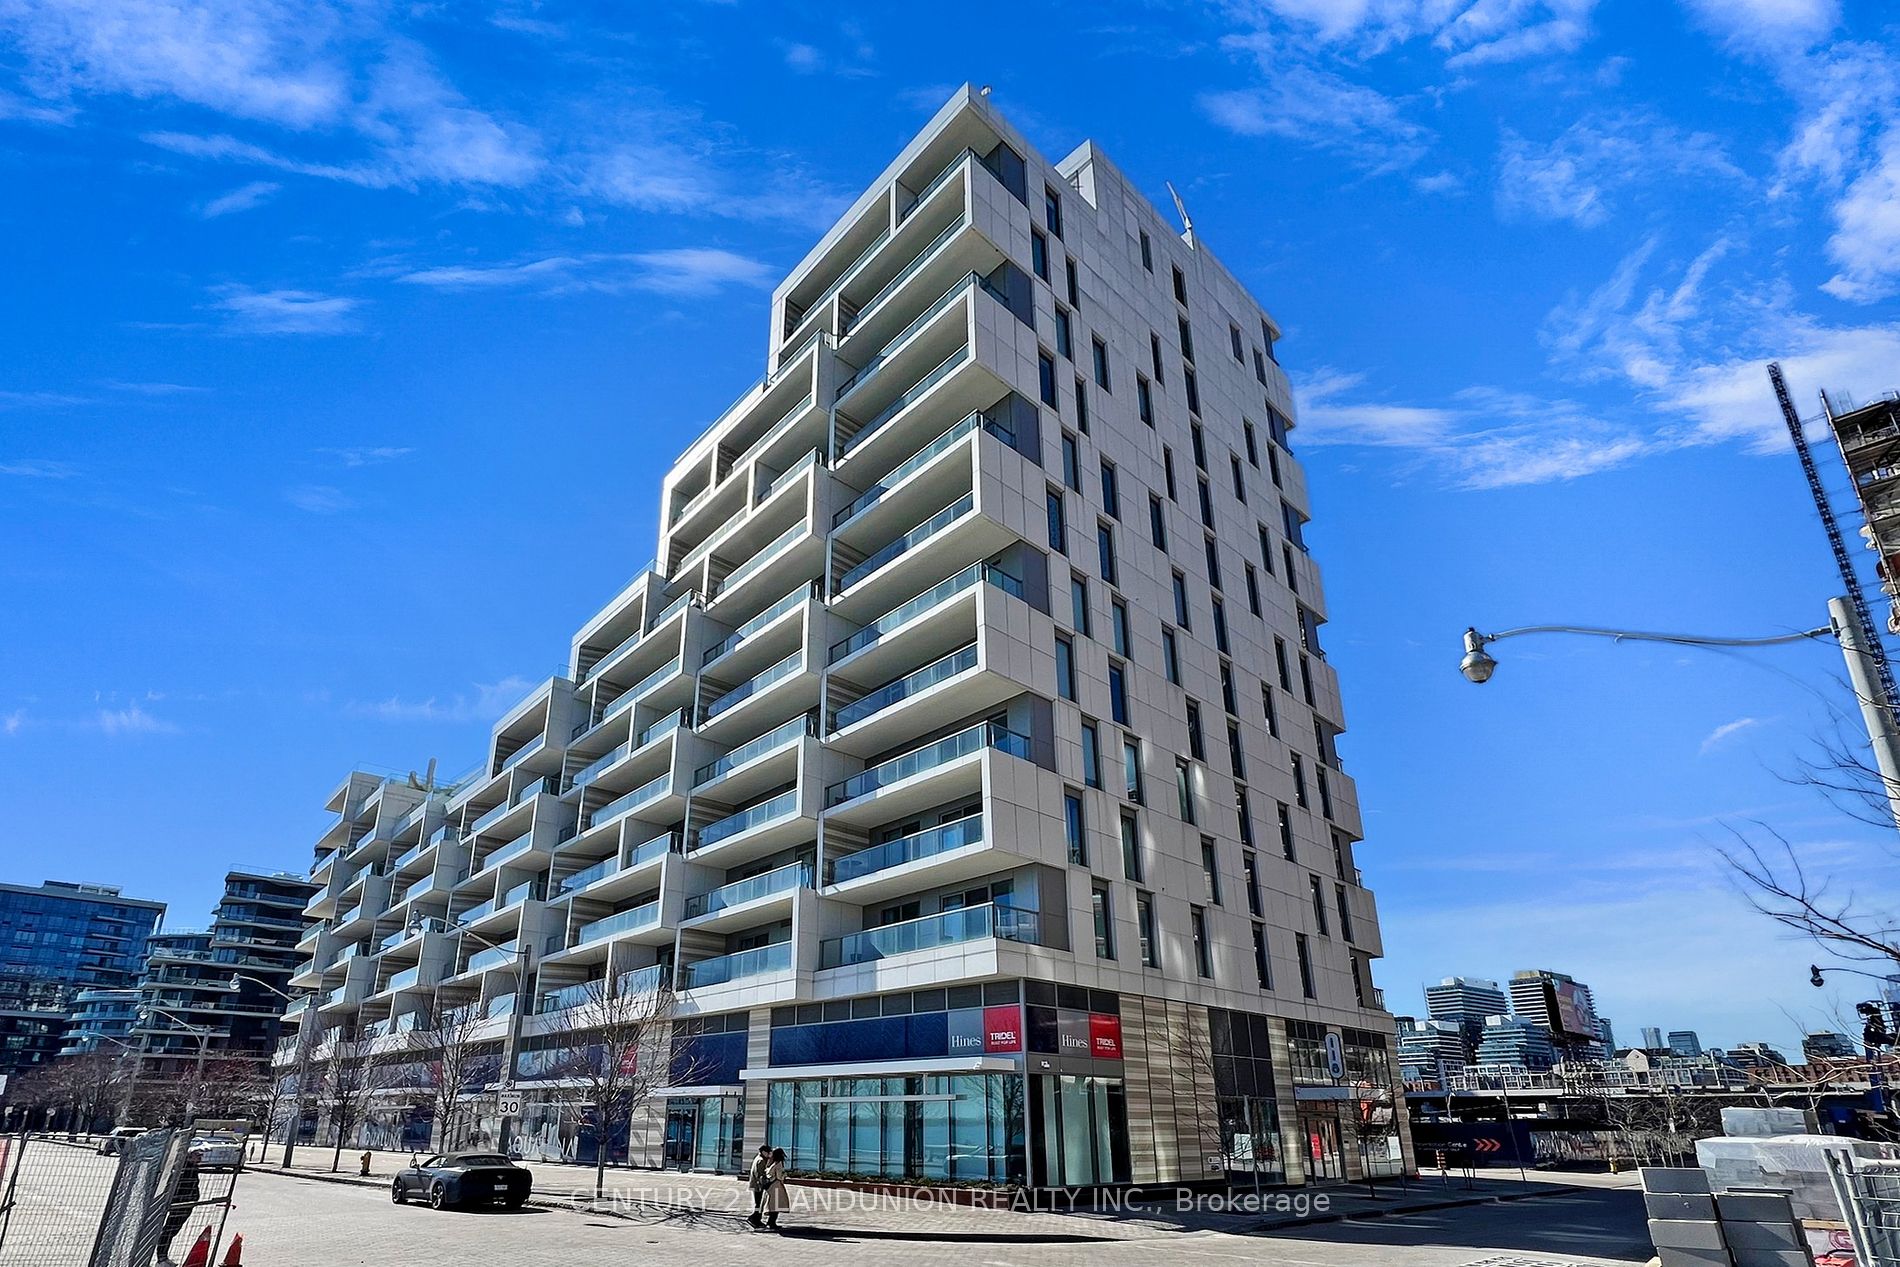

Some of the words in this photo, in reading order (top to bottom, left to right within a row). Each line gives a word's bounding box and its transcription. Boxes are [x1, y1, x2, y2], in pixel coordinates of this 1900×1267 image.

[951, 1034, 982, 1048] Hines
[990, 1031, 1016, 1040] TRIDEL
[1062, 1034, 1088, 1049] Hines
[1095, 1037, 1116, 1047] TRIDEL
[500, 1101, 518, 1113] 30
